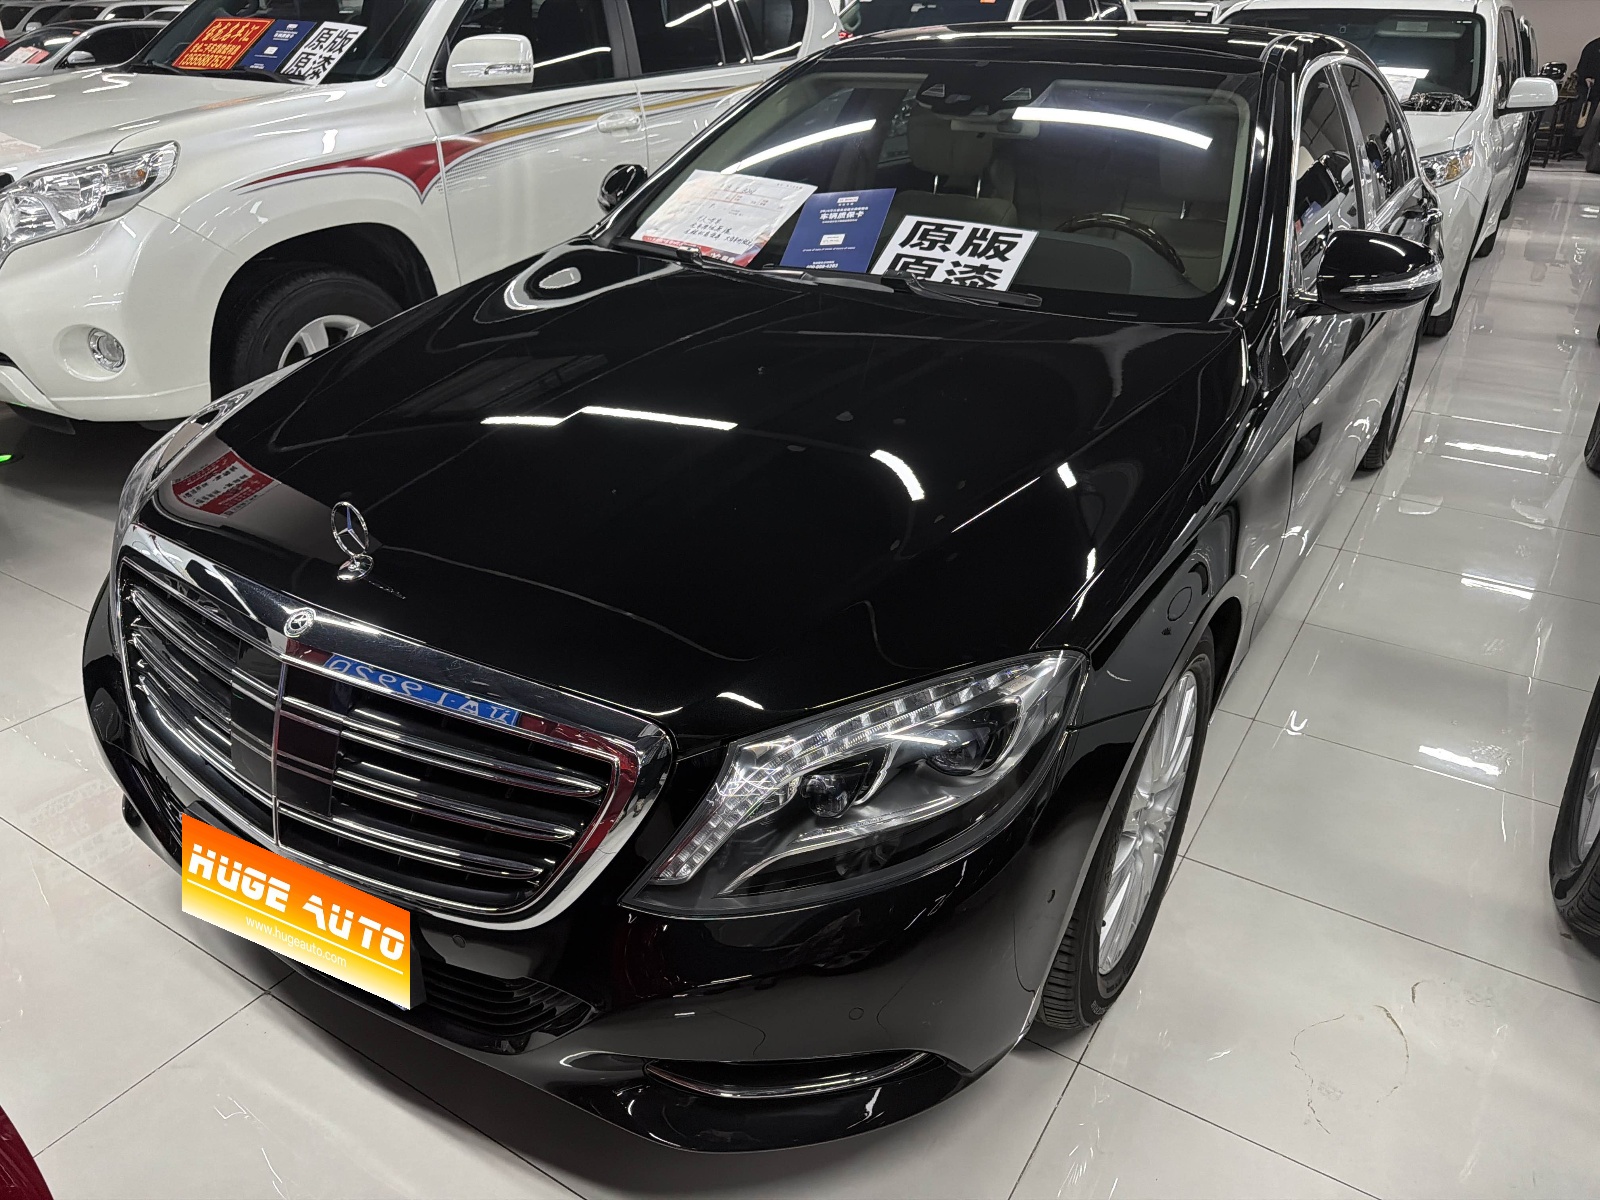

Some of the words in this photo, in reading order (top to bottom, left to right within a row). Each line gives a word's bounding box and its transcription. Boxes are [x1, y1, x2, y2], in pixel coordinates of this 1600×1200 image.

[304, 27, 359, 54] 原版
[280, 52, 336, 81] 原漆
[820, 210, 865, 220] 车辆质保卡
[899, 221, 1023, 262] 原版
[886, 253, 1003, 288] 原漆
